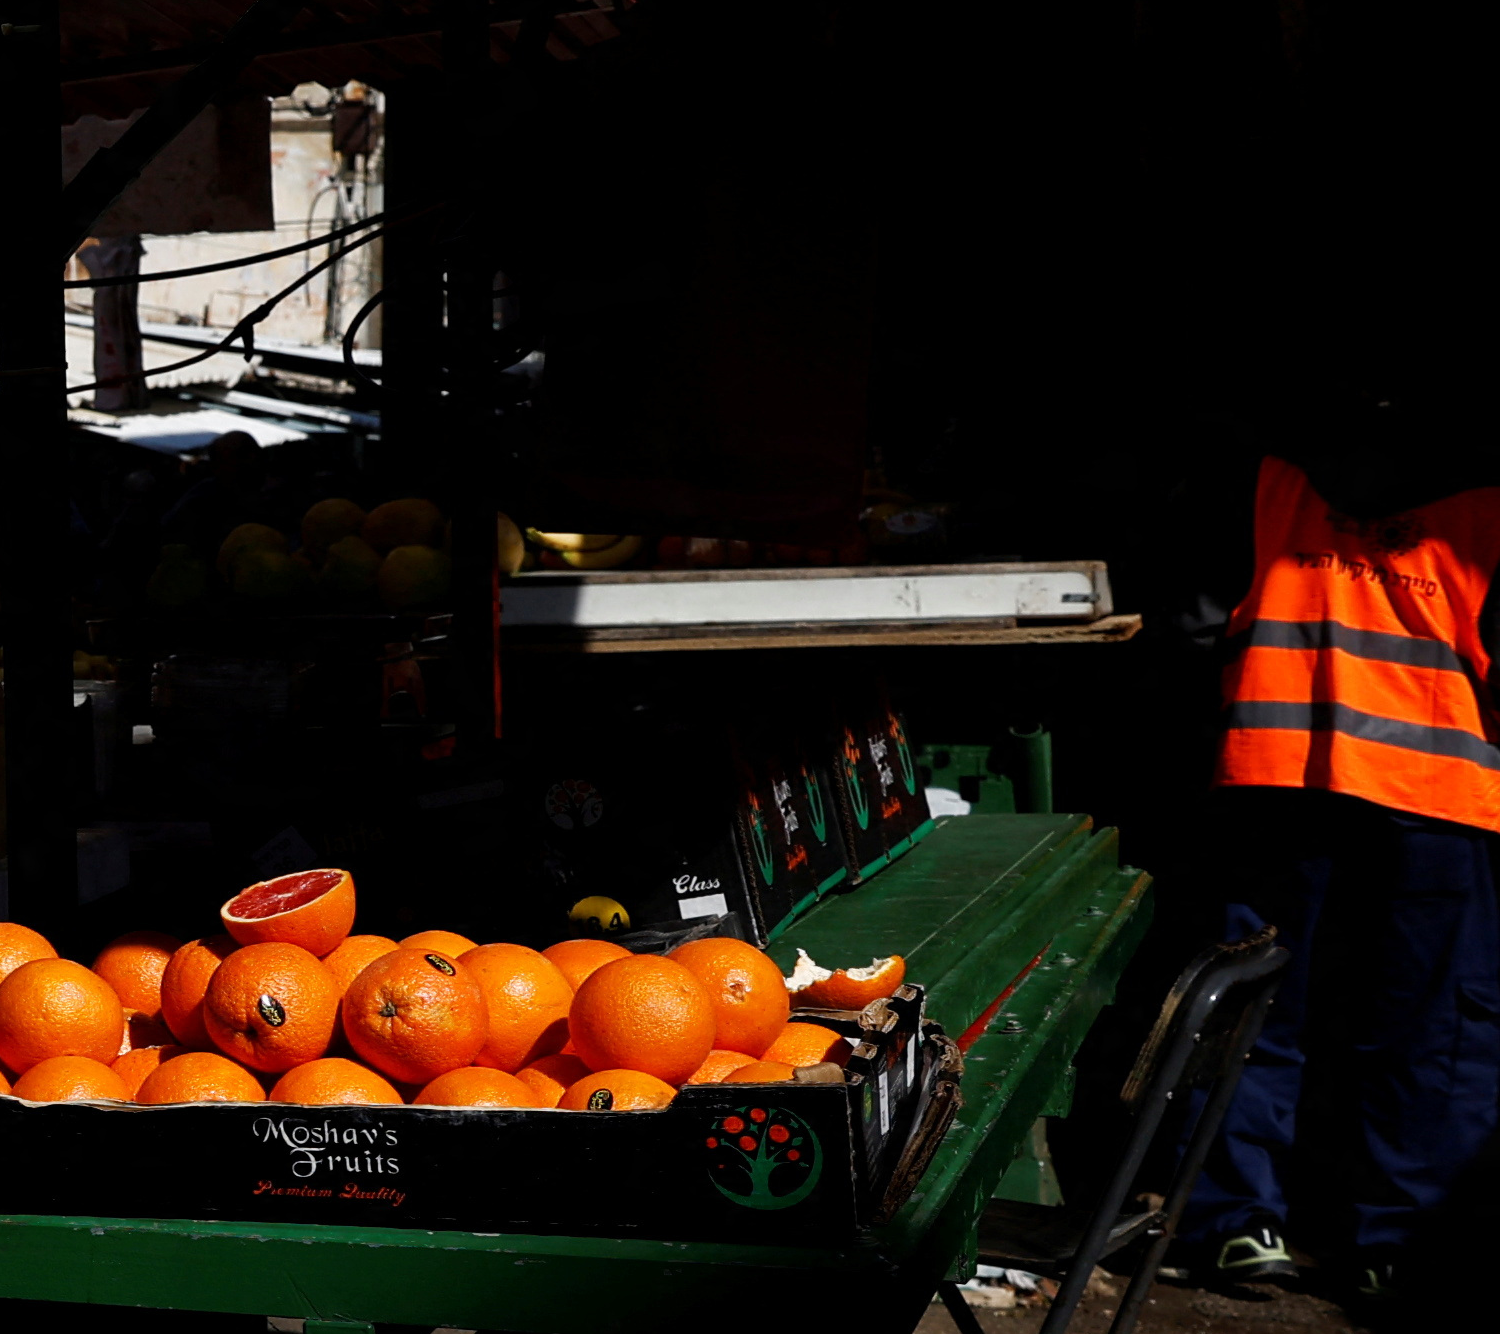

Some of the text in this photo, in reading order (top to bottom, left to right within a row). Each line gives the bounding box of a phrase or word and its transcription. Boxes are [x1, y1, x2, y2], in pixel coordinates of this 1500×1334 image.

[672, 874, 721, 894] Class
[253, 1117, 399, 1148] Moshav's
[290, 1147, 400, 1178] Fruits
[252, 1179, 408, 1208] Premium Quality
